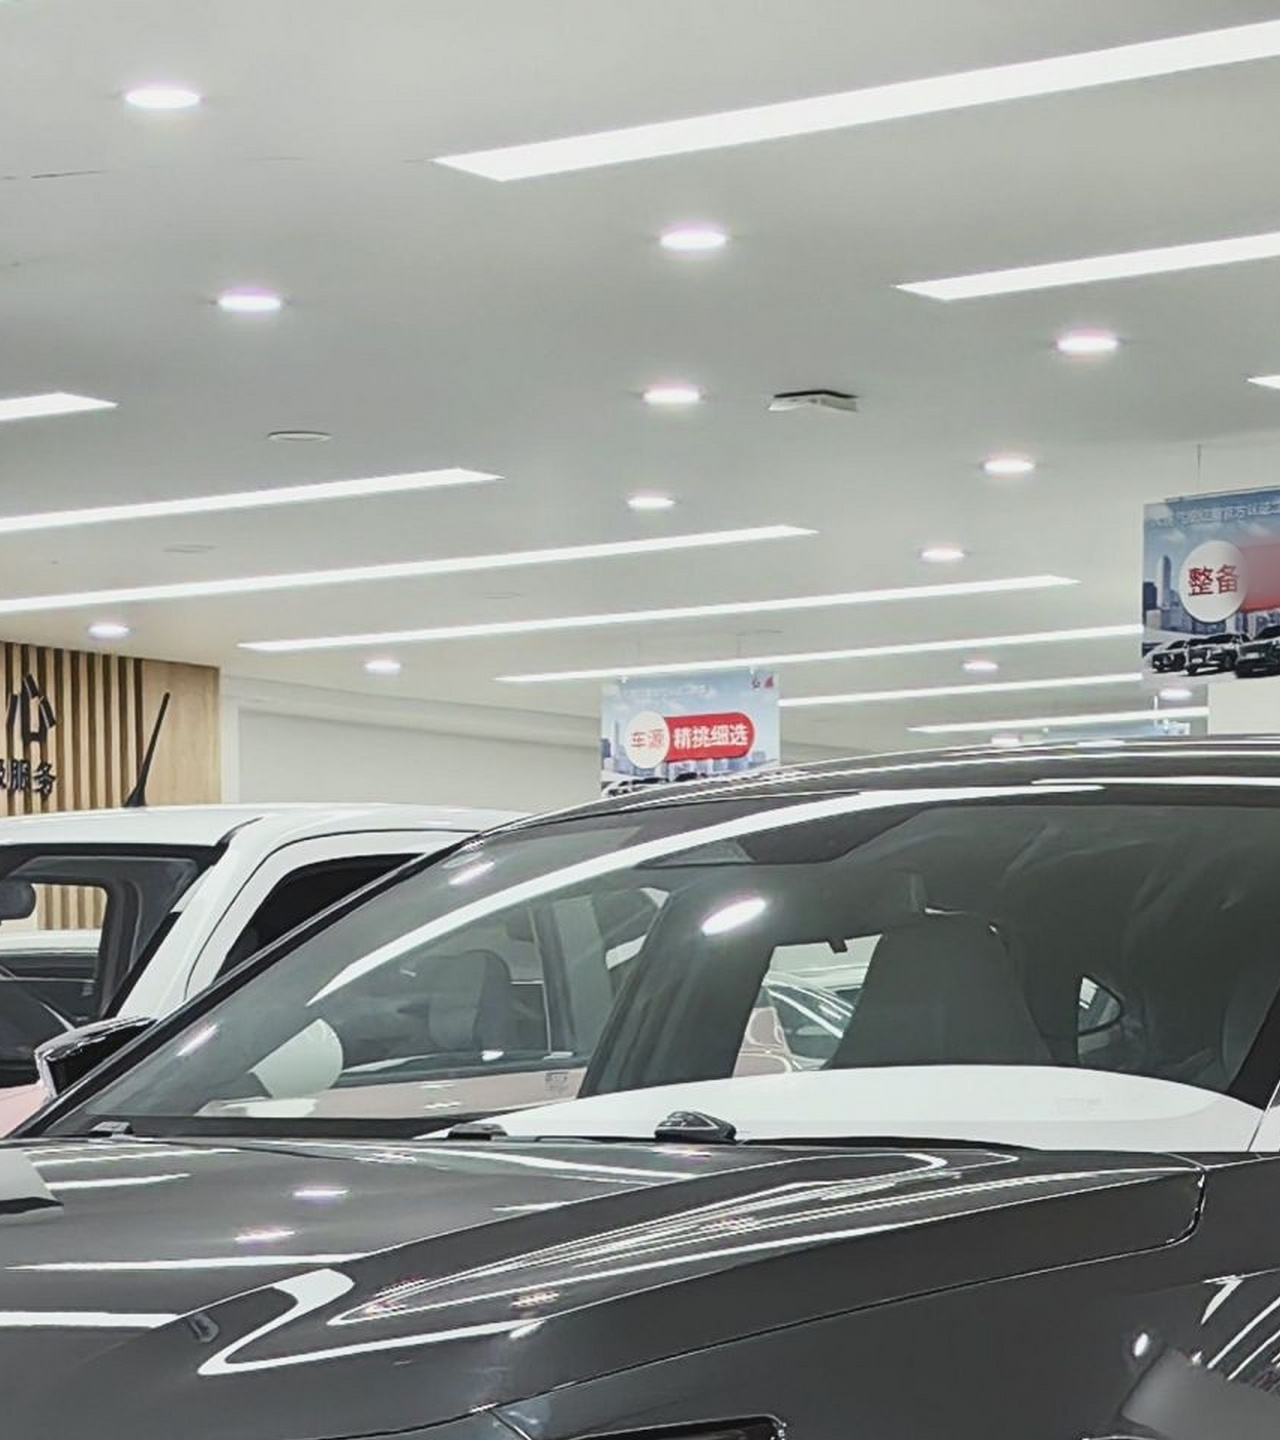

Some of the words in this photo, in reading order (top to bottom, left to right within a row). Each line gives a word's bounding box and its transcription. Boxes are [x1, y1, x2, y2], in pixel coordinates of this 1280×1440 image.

[1188, 564, 1238, 597] 整备
[673, 723, 748, 750] 精挑细选
